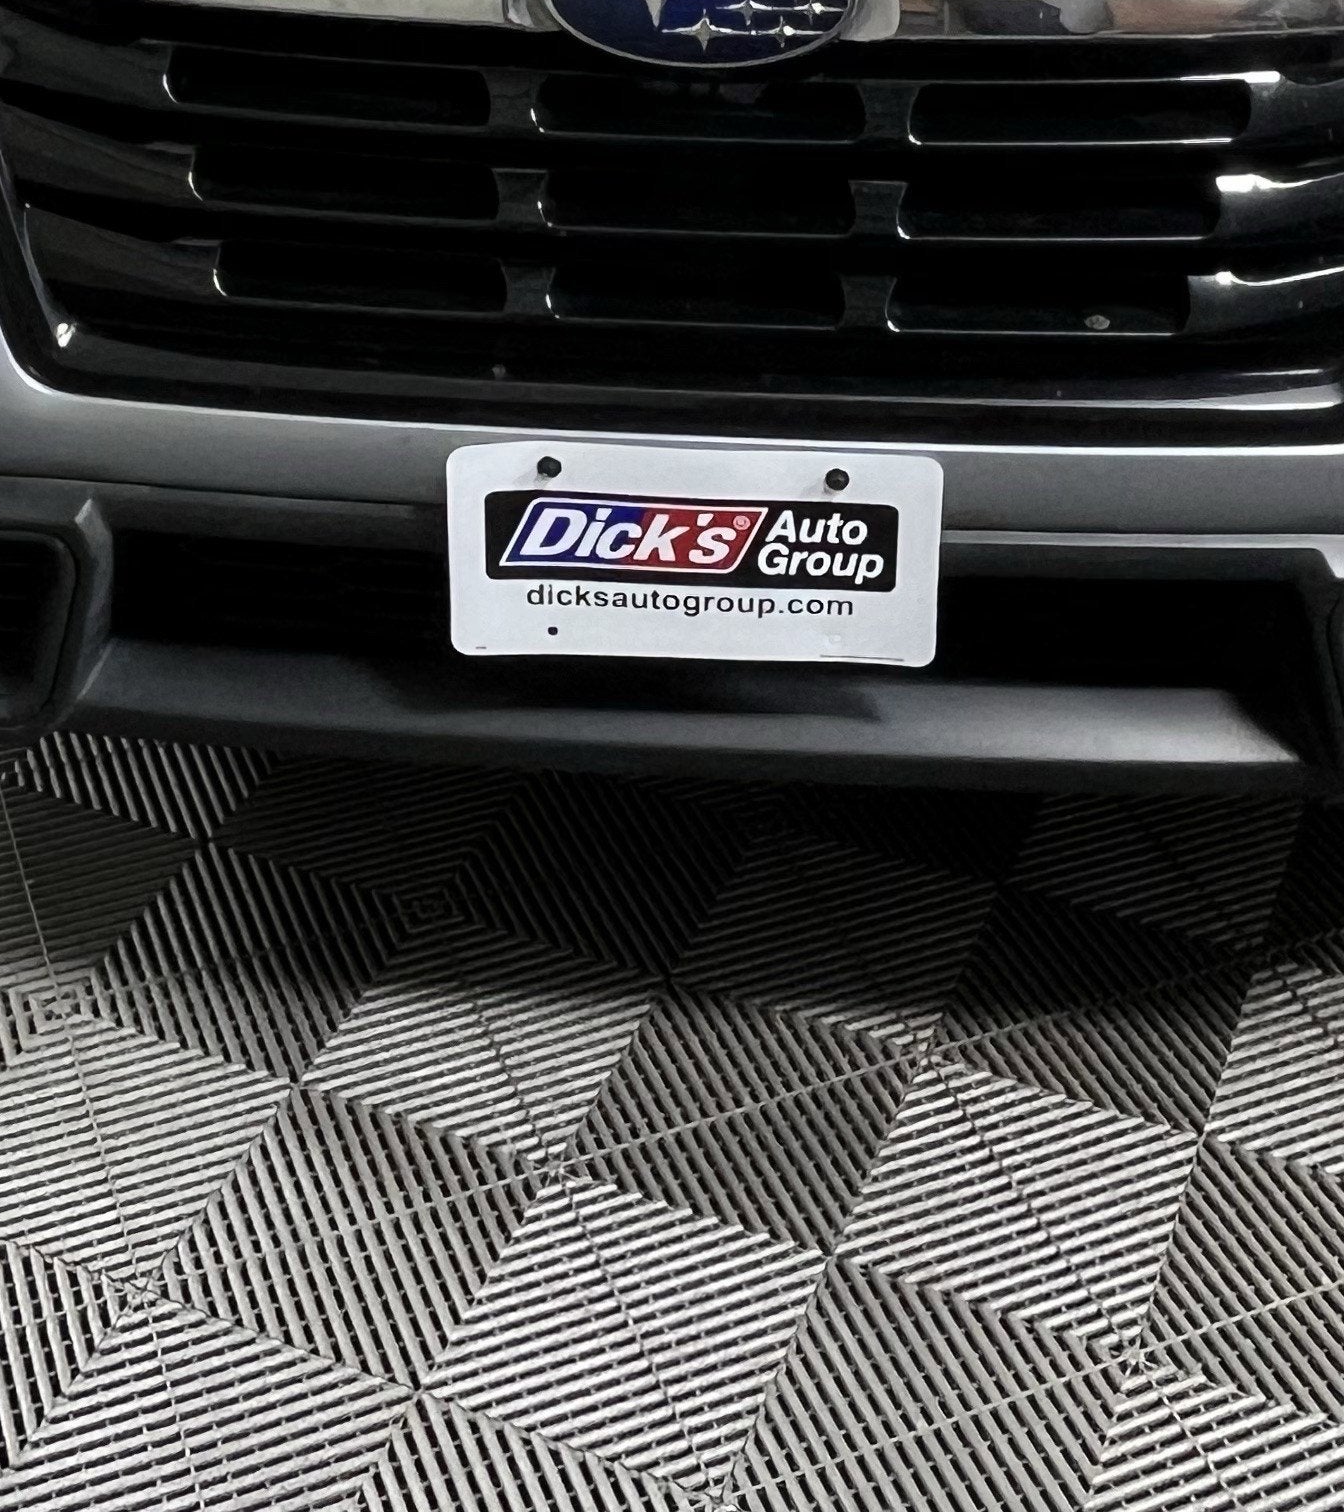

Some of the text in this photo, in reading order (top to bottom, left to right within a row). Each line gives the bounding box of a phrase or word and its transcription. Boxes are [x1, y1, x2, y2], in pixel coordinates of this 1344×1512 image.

[520, 507, 737, 565] Dick's
[765, 510, 868, 545] Auto
[758, 543, 884, 584] Group
[526, 584, 854, 618] dicksautogroup.com
